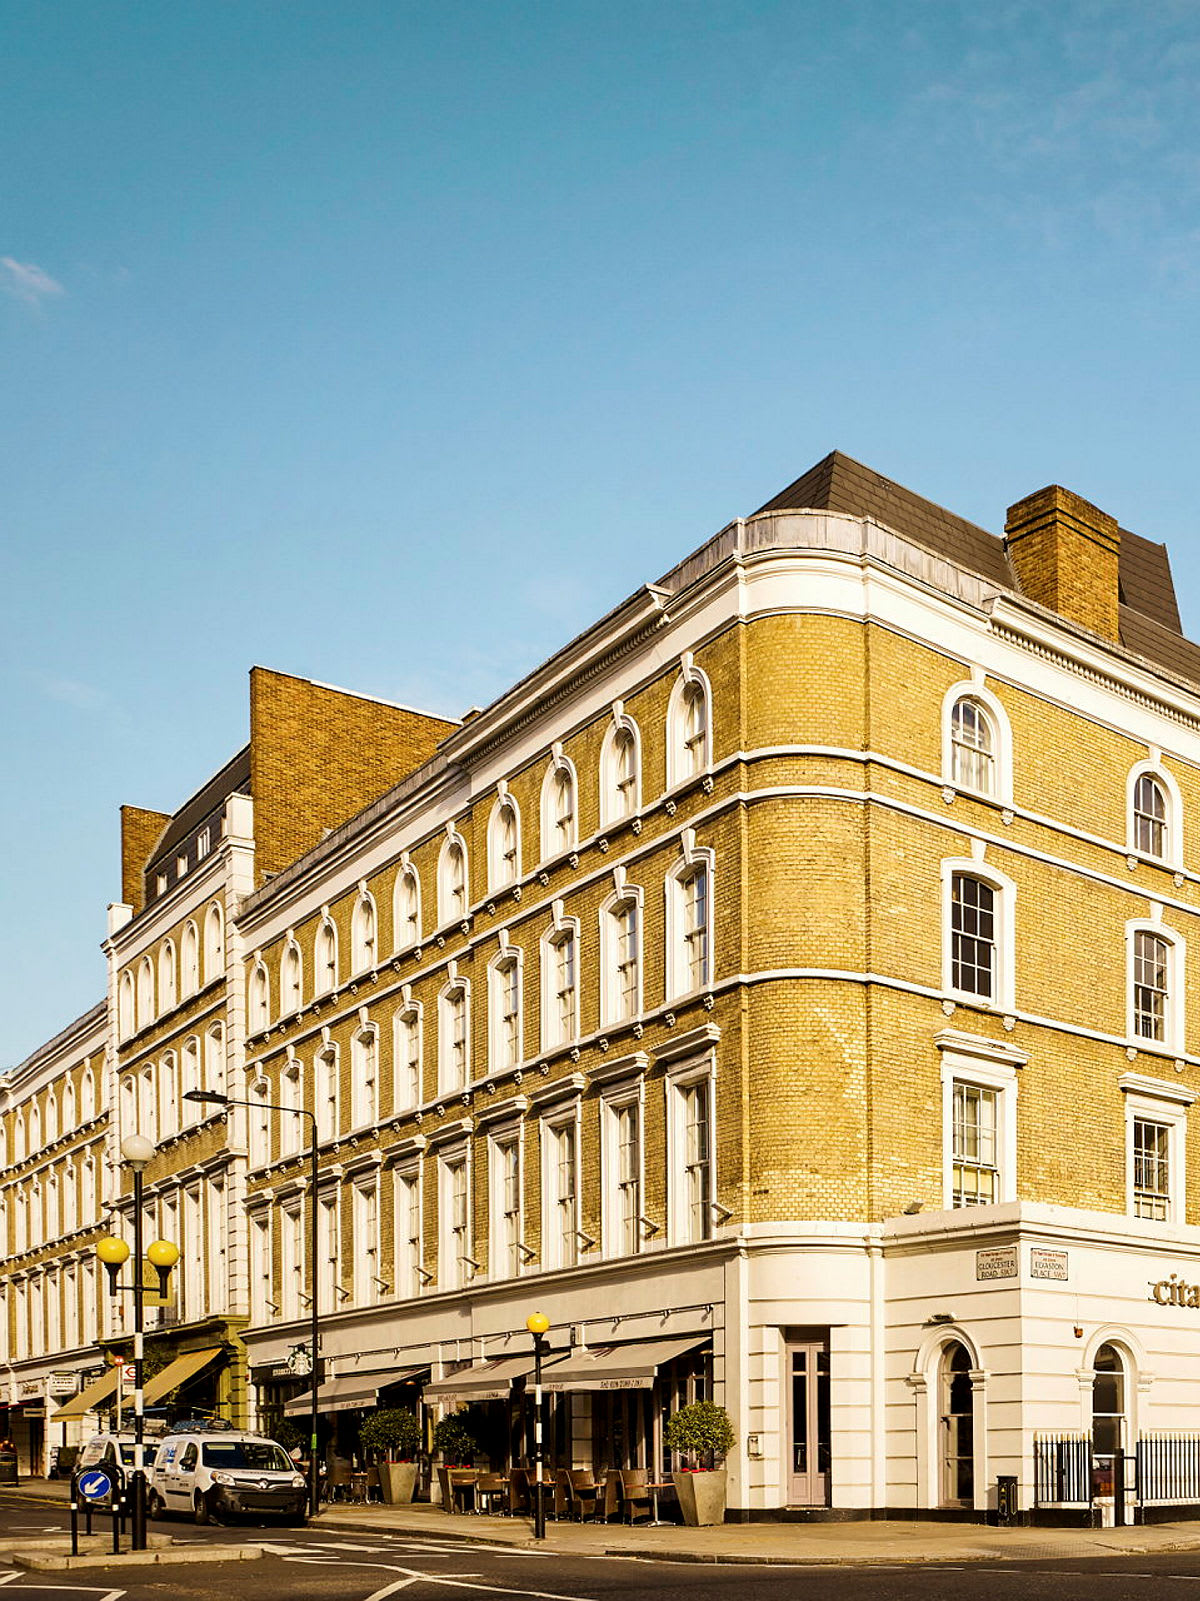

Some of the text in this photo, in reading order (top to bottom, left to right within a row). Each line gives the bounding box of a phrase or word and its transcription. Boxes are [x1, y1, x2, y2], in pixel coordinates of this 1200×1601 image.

[979, 1260, 1015, 1270] GLOUCESTER
[981, 1270, 998, 1278] ROAD
[1033, 1269, 1050, 1278] PLACE
